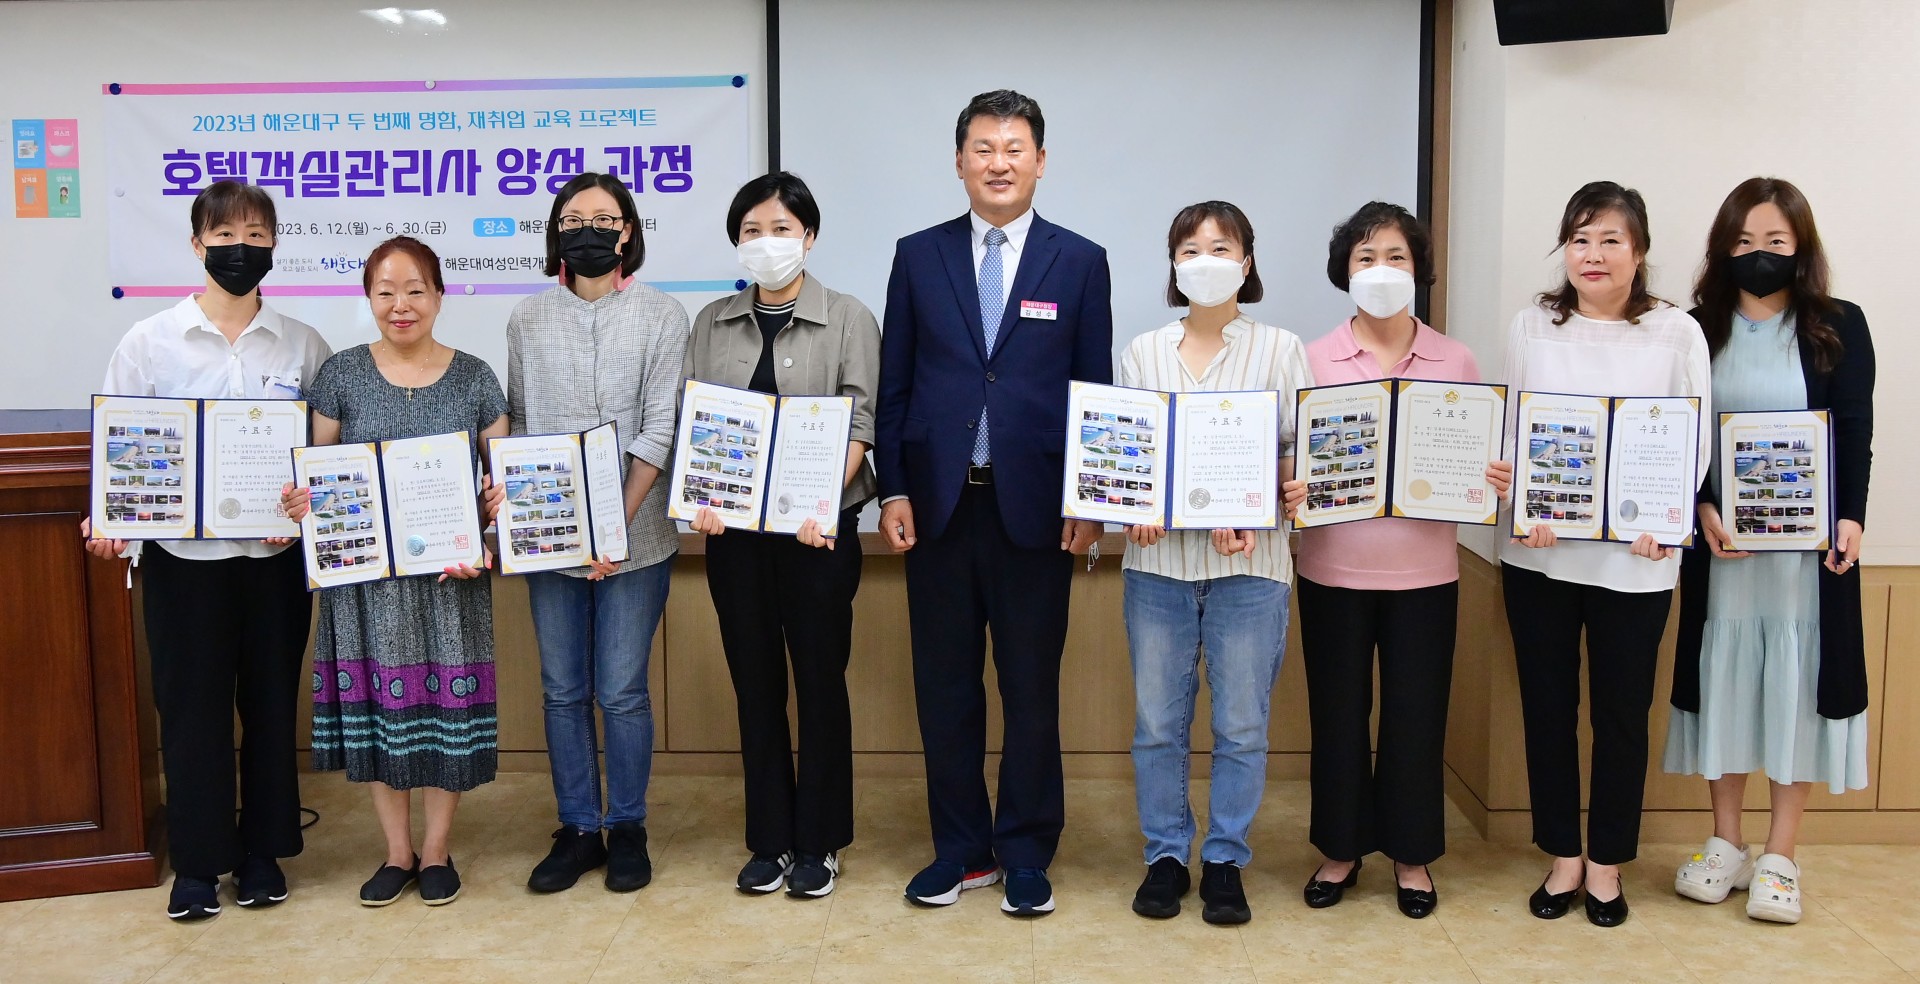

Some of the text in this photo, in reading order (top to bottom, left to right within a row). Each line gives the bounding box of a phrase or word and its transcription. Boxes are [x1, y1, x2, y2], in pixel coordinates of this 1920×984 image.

[192, 108, 657, 132] 2023년 해운대구 두 번째 명함, 재취업 교육 프로젝트
[162, 148, 481, 198] 호텔객실관리사
[277, 222, 306, 236] 023.
[310, 222, 322, 235] 6.
[328, 221, 369, 236] 12.(월)
[386, 222, 398, 235] 6.
[402, 220, 447, 236] 30.(금)
[482, 220, 509, 235] 장소
[444, 256, 550, 271] 해운대여성인력개
